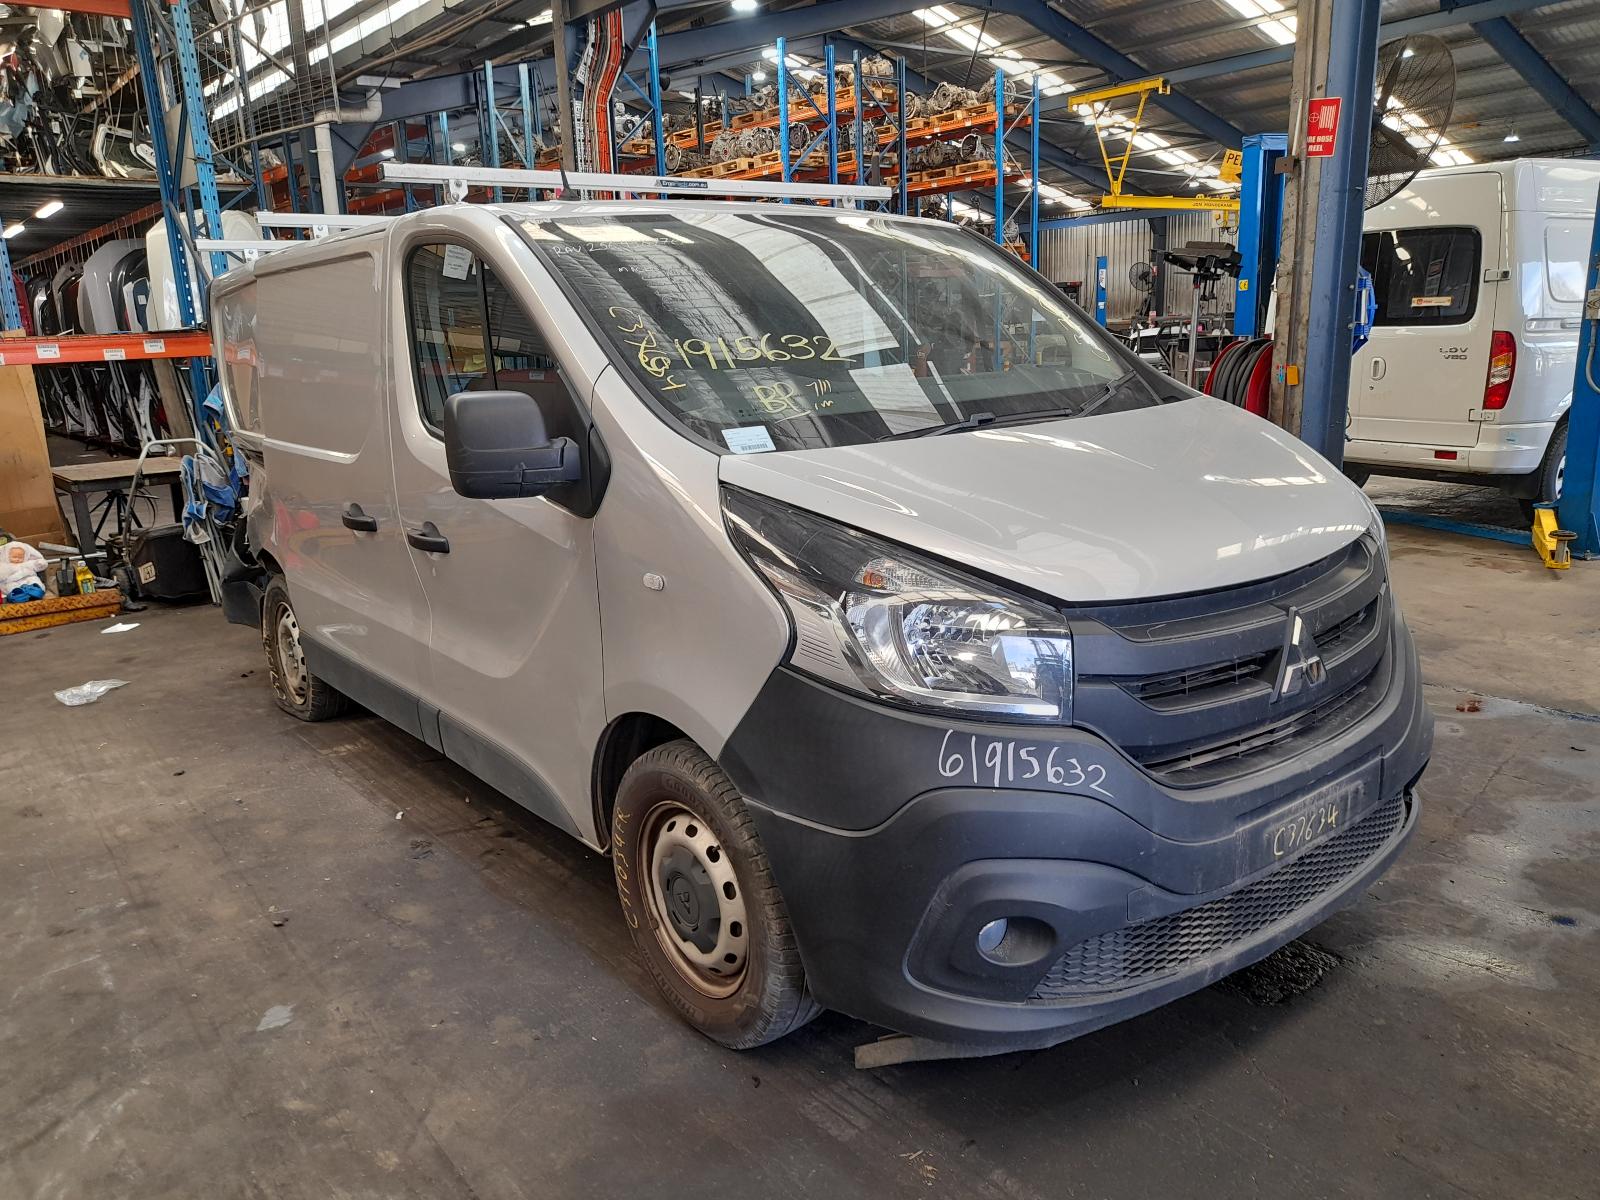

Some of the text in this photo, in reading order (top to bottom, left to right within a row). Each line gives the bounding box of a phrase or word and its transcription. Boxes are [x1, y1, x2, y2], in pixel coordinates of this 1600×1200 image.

[1317, 134, 1334, 143] HOSE
[1308, 144, 1323, 152] REEL
[1226, 152, 1242, 166] PE
[937, 728, 1115, 798] 61915632
[1273, 803, 1340, 857] C37634
